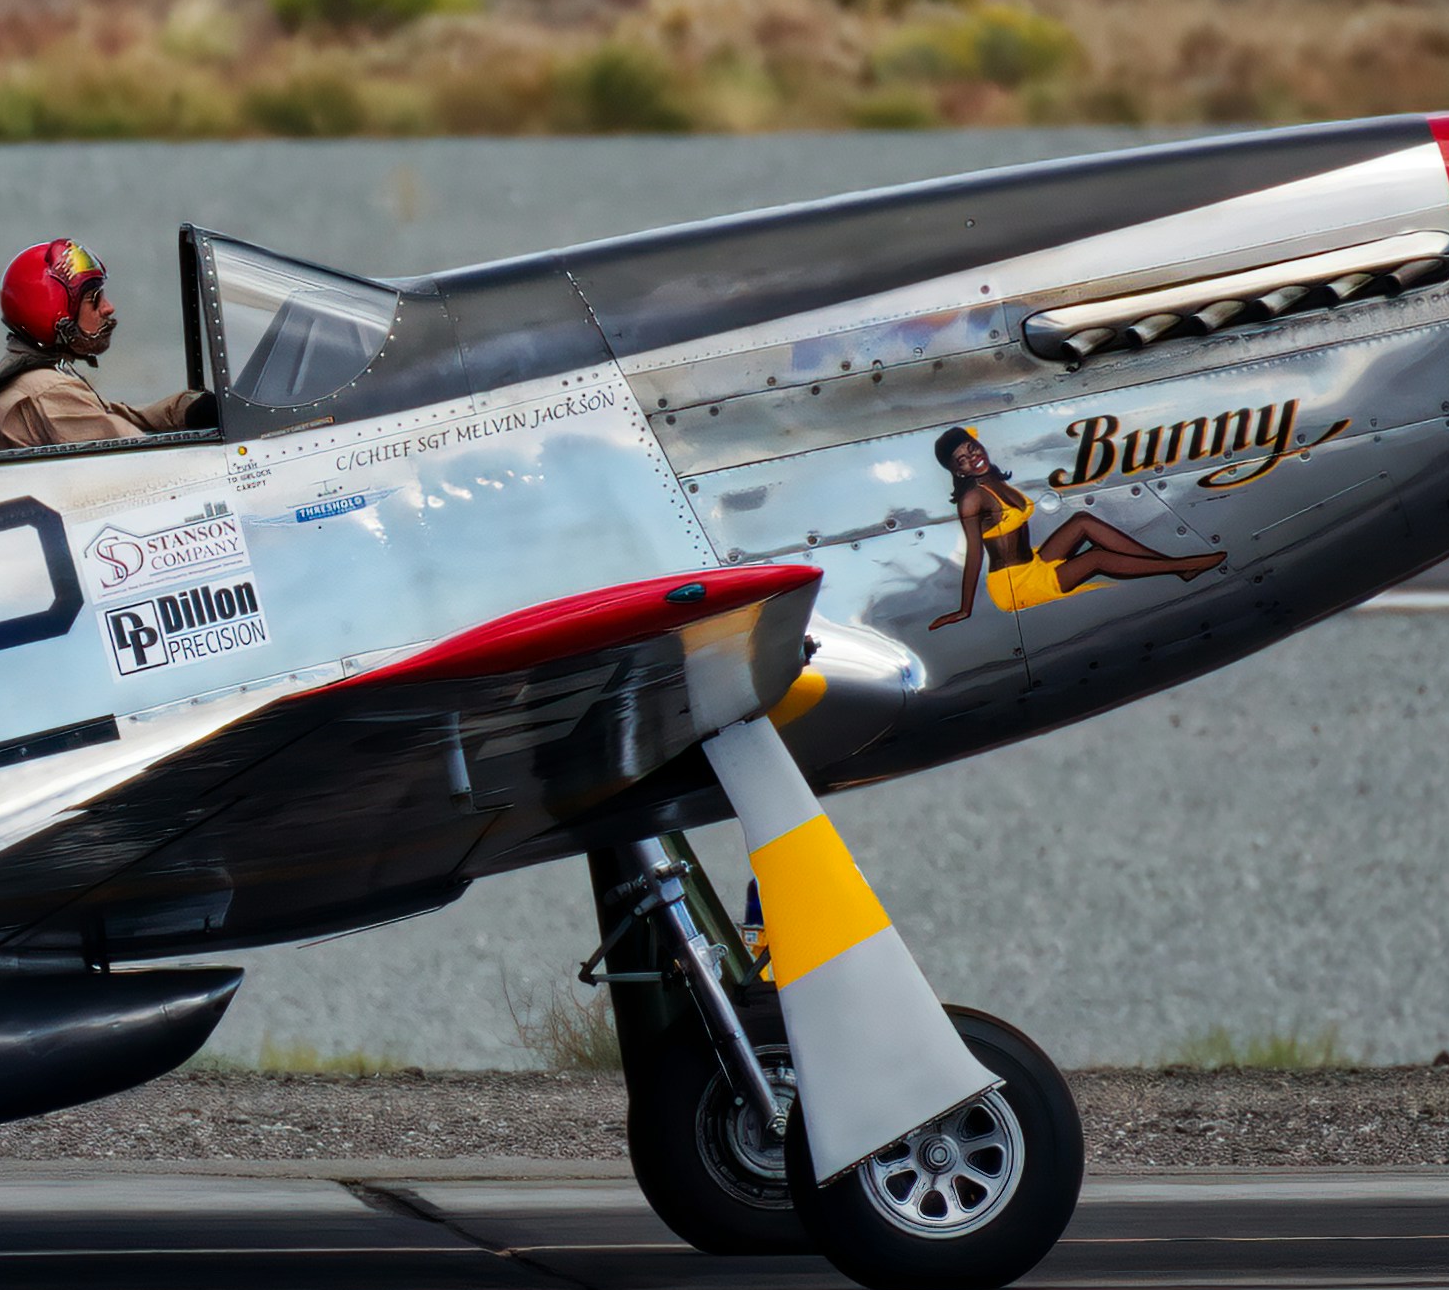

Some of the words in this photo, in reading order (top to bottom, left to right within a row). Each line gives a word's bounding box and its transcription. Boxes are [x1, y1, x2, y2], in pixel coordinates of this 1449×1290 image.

[336, 440, 412, 471] C/CHIEF
[417, 430, 450, 453] SGT
[456, 412, 526, 443] MELVIN
[531, 392, 616, 429] JACKSON
[1048, 398, 1351, 489] Bunny
[147, 518, 238, 554] STANSON
[151, 537, 239, 570] COMPANY
[156, 581, 259, 634] Dillon
[168, 619, 266, 663] PRECISION
